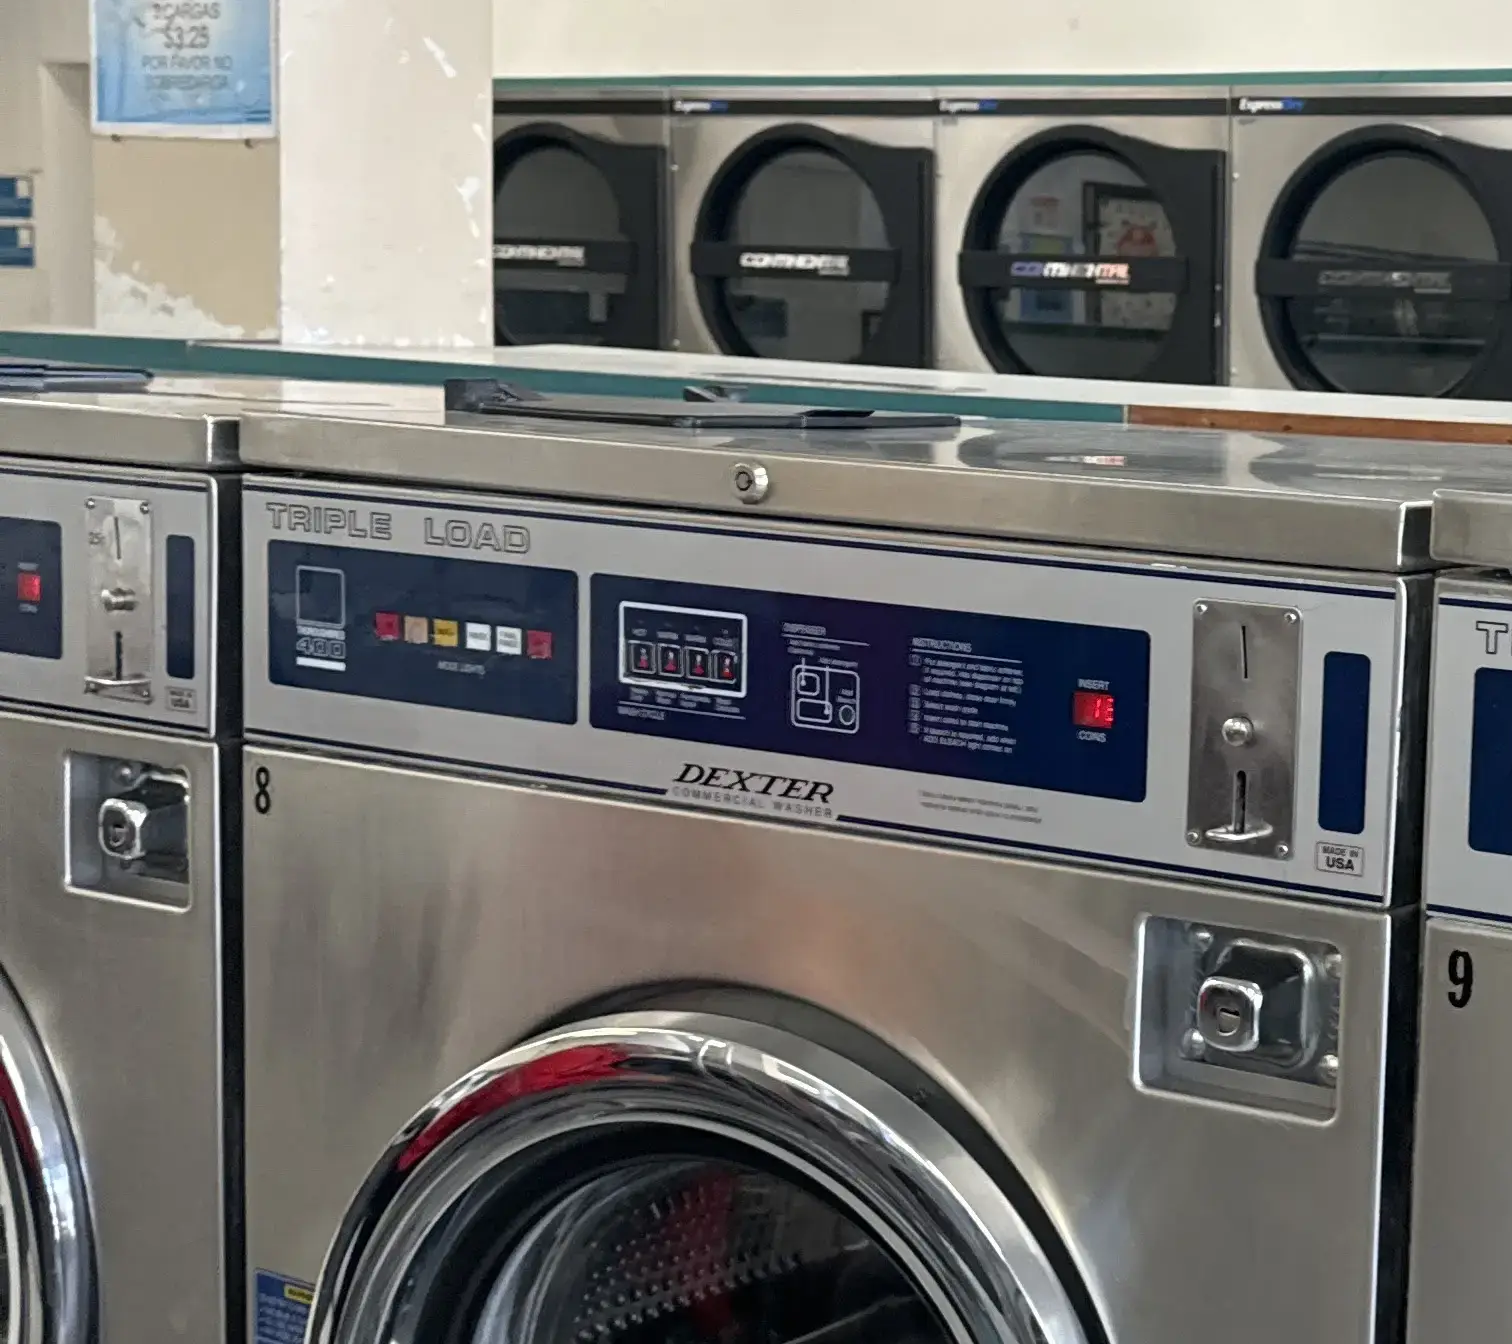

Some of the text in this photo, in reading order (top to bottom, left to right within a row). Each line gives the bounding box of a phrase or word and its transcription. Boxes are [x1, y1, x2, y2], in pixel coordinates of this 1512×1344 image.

[266, 502, 532, 555] TRIPLE LOAD
[296, 637, 346, 659] 400
[254, 766, 272, 815] 8
[671, 785, 766, 808] COMMERCIAL
[673, 763, 835, 804] DEXTER
[1326, 855, 1355, 872] USA
[1448, 950, 1474, 1009] 9
